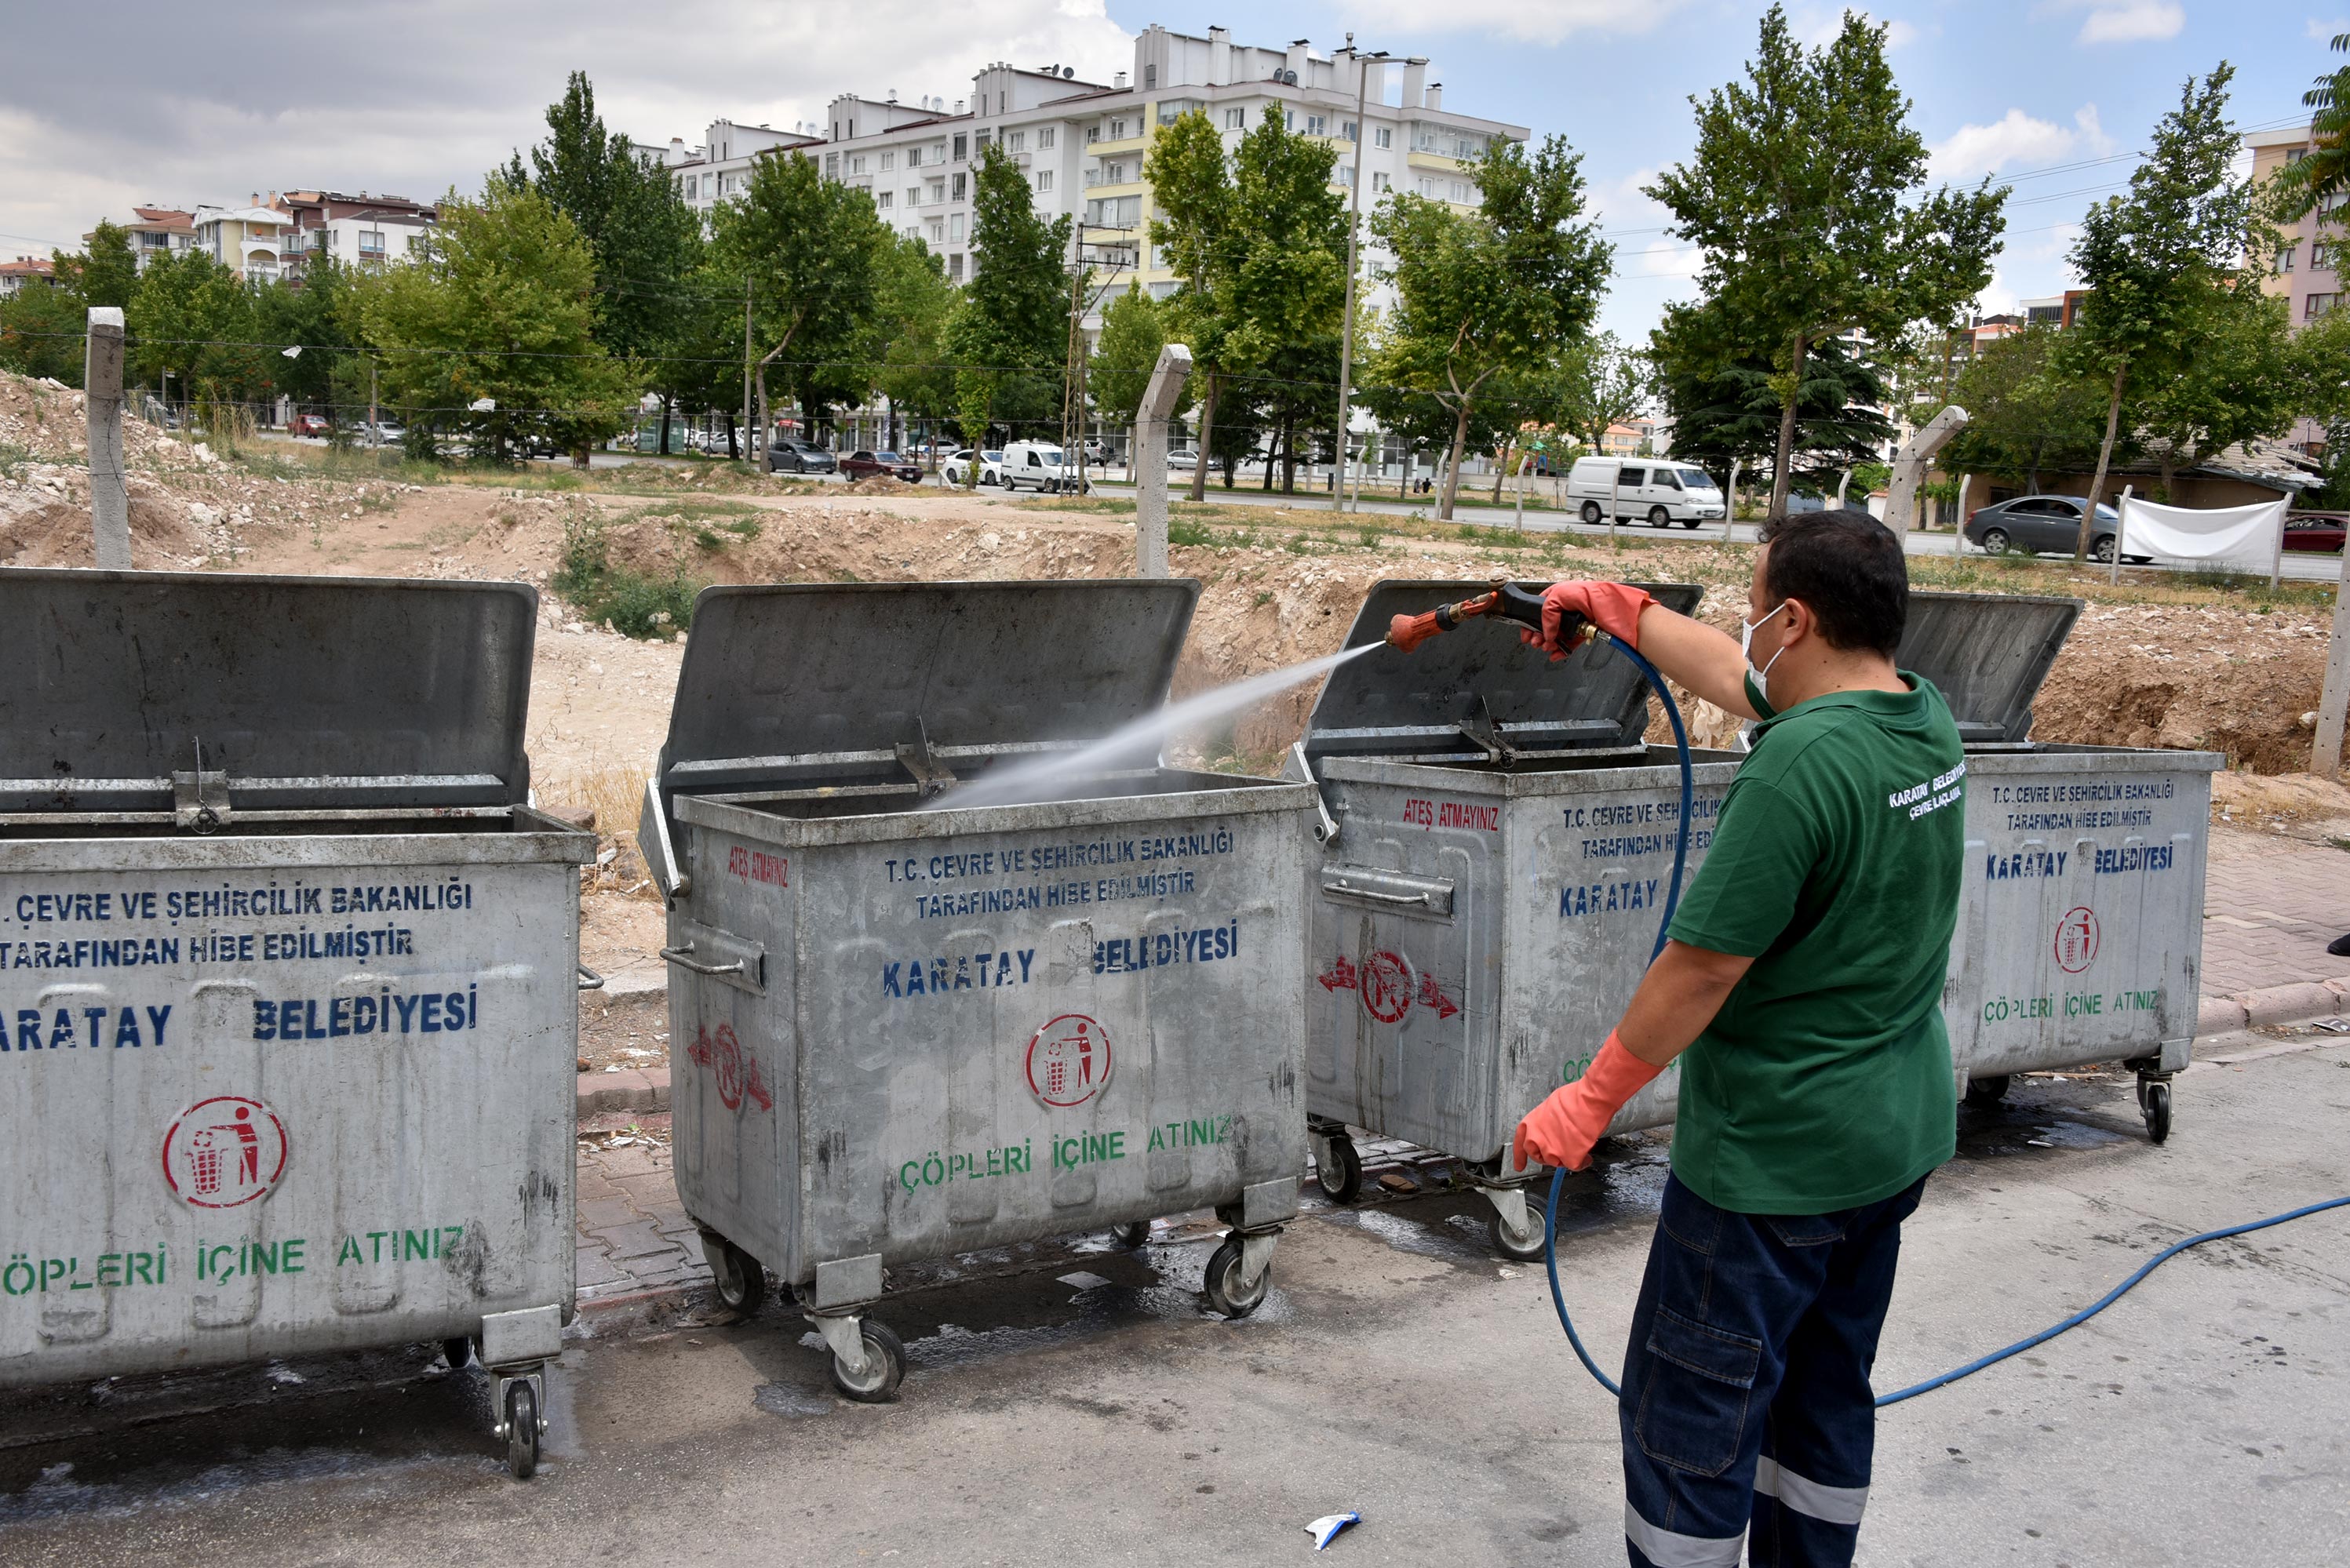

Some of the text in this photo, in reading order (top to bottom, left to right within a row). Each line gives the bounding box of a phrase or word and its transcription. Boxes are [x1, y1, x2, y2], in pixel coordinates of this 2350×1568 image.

[1889, 781, 1929, 808] KARATAY
[1909, 799, 1933, 820] ÇEVRE
[2017, 786, 2049, 807] ÇEVRE
[2053, 785, 2065, 802] VE
[2068, 780, 2122, 806] ŞEHİRCİLİK
[2125, 779, 2173, 799] BAKANLIĞI
[1403, 799, 1499, 831] ATEŞ ATMAYINIZ
[1592, 805, 1633, 831] ÇEVRE
[1637, 803, 1652, 823] VE
[1656, 795, 1722, 826] ŞEHCİLİK
[2008, 806, 2151, 831] TARAFINDAN HİBE EDİLMİŞTİR
[931, 852, 993, 885] ÇEVRE
[1001, 849, 1025, 873] VE
[1032, 836, 1135, 877] ŞEHİRCİLİK
[1141, 826, 1234, 861] BAKANLIĞI
[1582, 835, 1661, 859] TARAFINDAN
[1666, 828, 1692, 851] HİE
[1987, 841, 2173, 880] KARATAY BELEDİYESİ
[729, 846, 789, 888] ATEŞ ATMAYINIZ
[16, 876, 472, 930] ÇEVRE VE ŞEHİRCİLİK BAKANLIĞI
[916, 866, 1195, 919] TARAFINDAN HİBE EDİLMİŞTİR
[1560, 879, 1658, 918] KARATAY
[0, 922, 414, 970] TARAFINDAN HİBE EDİLMİŞTİR
[884, 918, 1237, 998] KARATAY BELEDİYESİ
[253, 983, 477, 1041] BELEDİYESİ
[2064, 991, 2102, 1018] İÇİNE
[2114, 989, 2159, 1012] ATINIZ
[900, 1115, 1233, 1197] ÇÖPLERİ İÇİNE ATINIZ
[2, 1225, 465, 1296] ÖPLERİ İÇİNE ATINIZ
